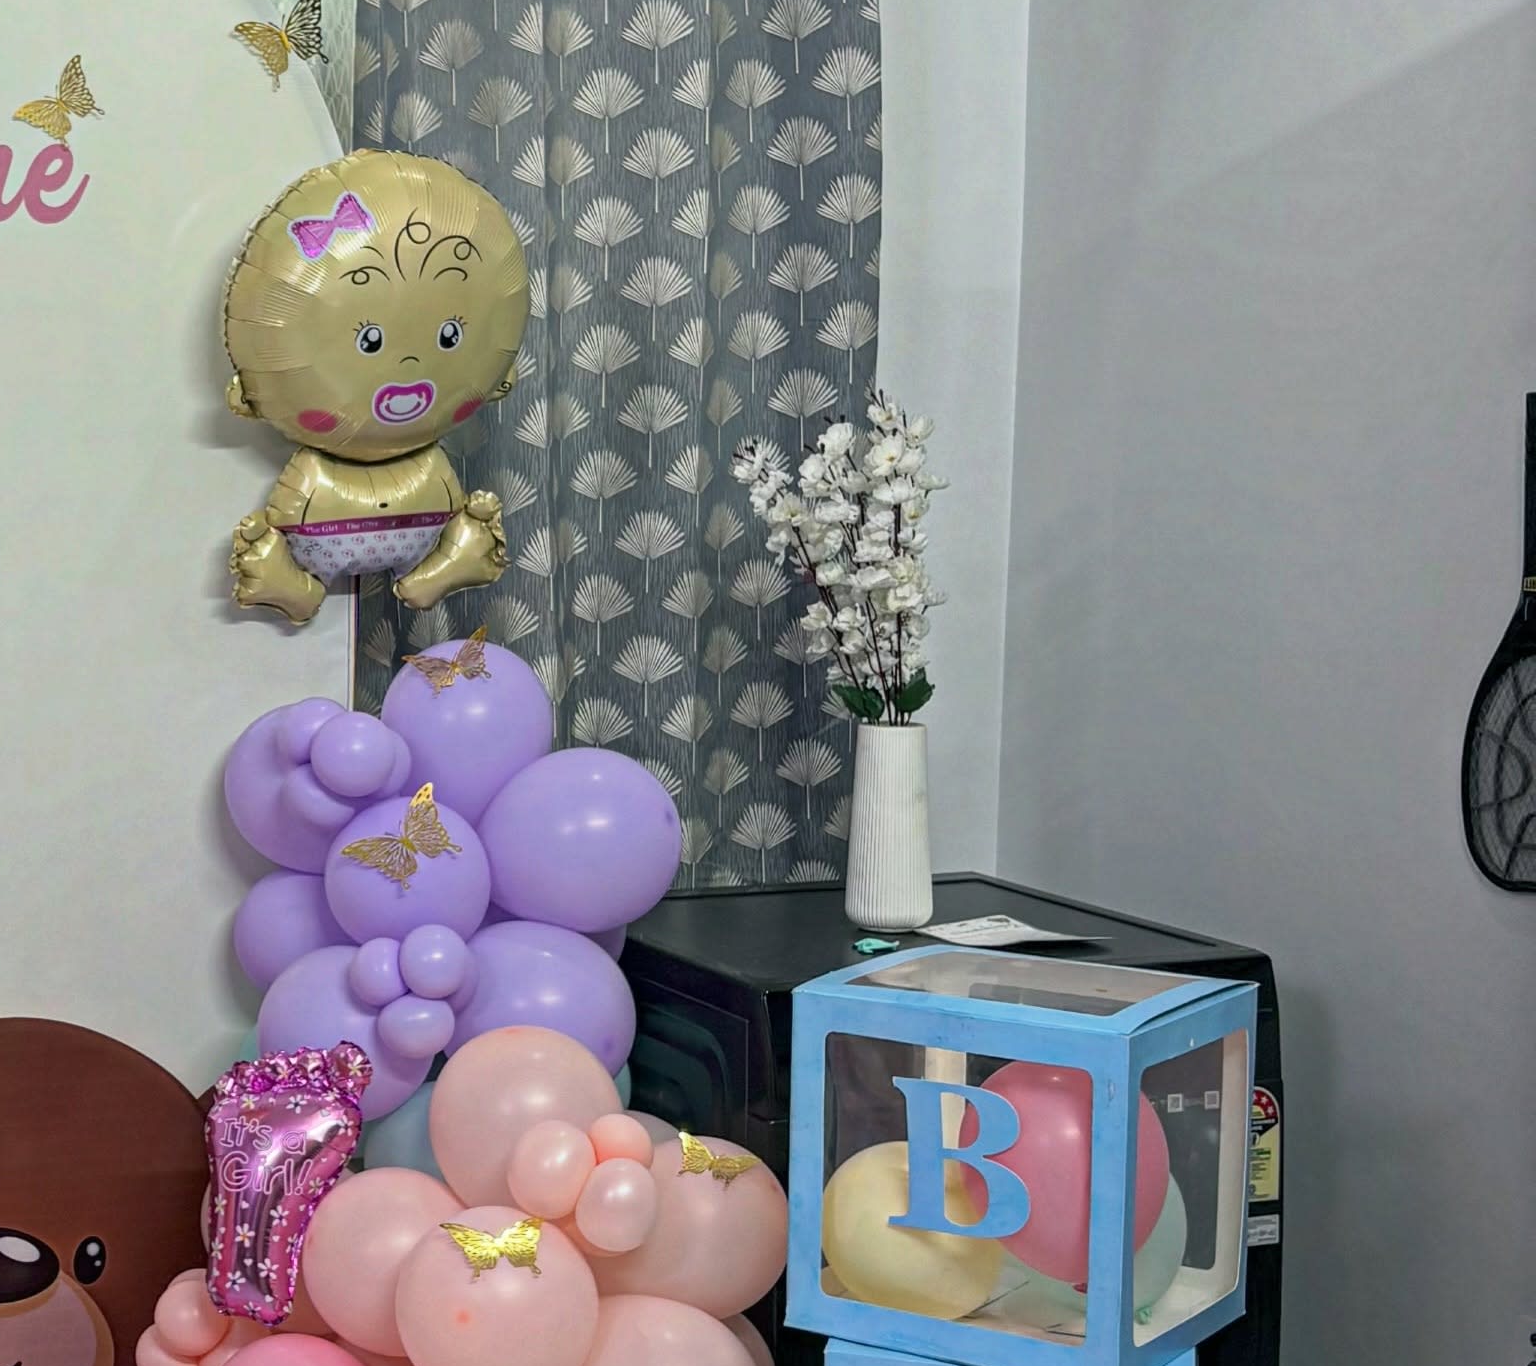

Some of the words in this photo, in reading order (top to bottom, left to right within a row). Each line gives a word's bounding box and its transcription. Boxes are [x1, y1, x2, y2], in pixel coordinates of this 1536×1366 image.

[219, 1116, 273, 1152] It's
[281, 1130, 307, 1156] a
[888, 1076, 1031, 1239] B
[220, 1151, 313, 1195] Girl!
